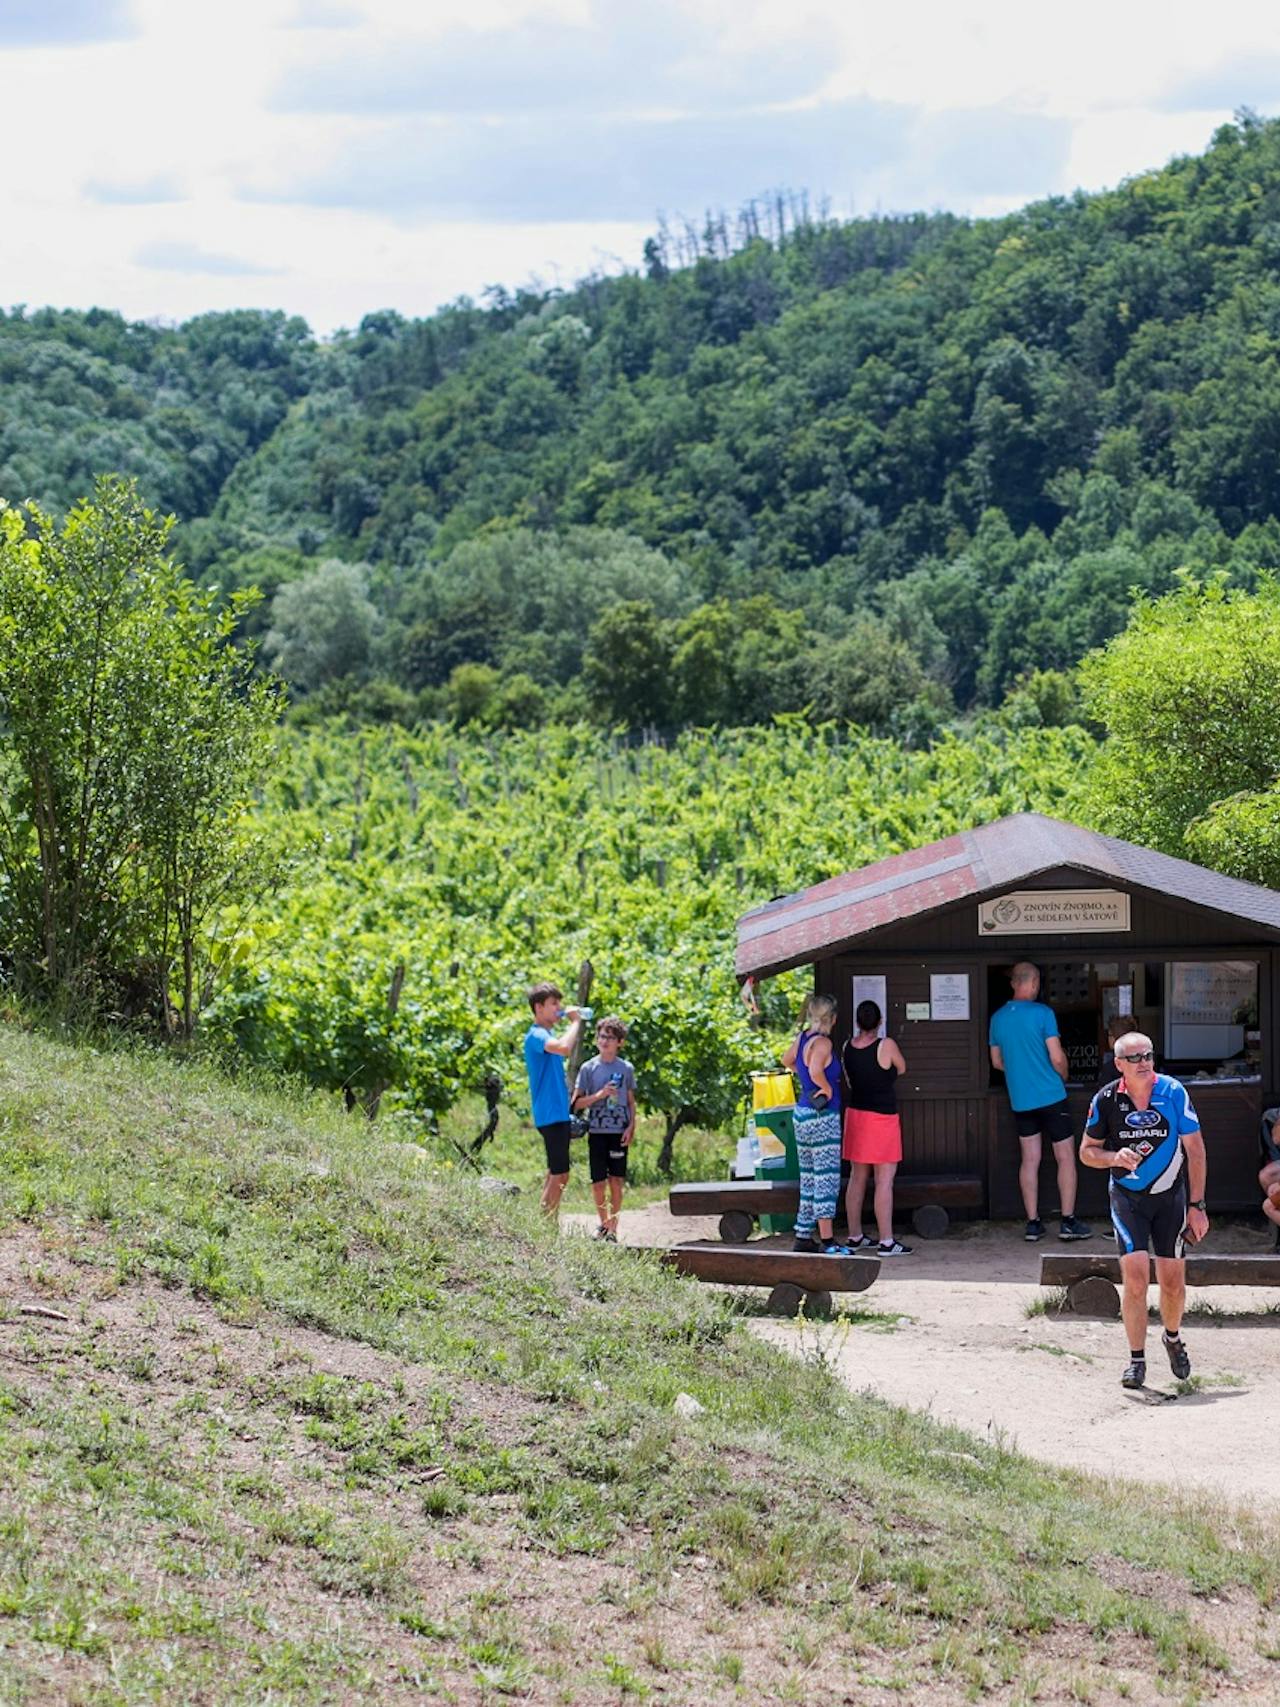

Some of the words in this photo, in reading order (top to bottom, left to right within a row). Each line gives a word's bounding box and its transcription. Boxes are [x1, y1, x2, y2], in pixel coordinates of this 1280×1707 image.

[1023, 902, 1061, 911] ZNOVÍN
[1037, 912, 1072, 921] SÍDLEM
[1082, 911, 1118, 920] ŠATOVĚ
[1118, 1129, 1168, 1139] SUBARU
